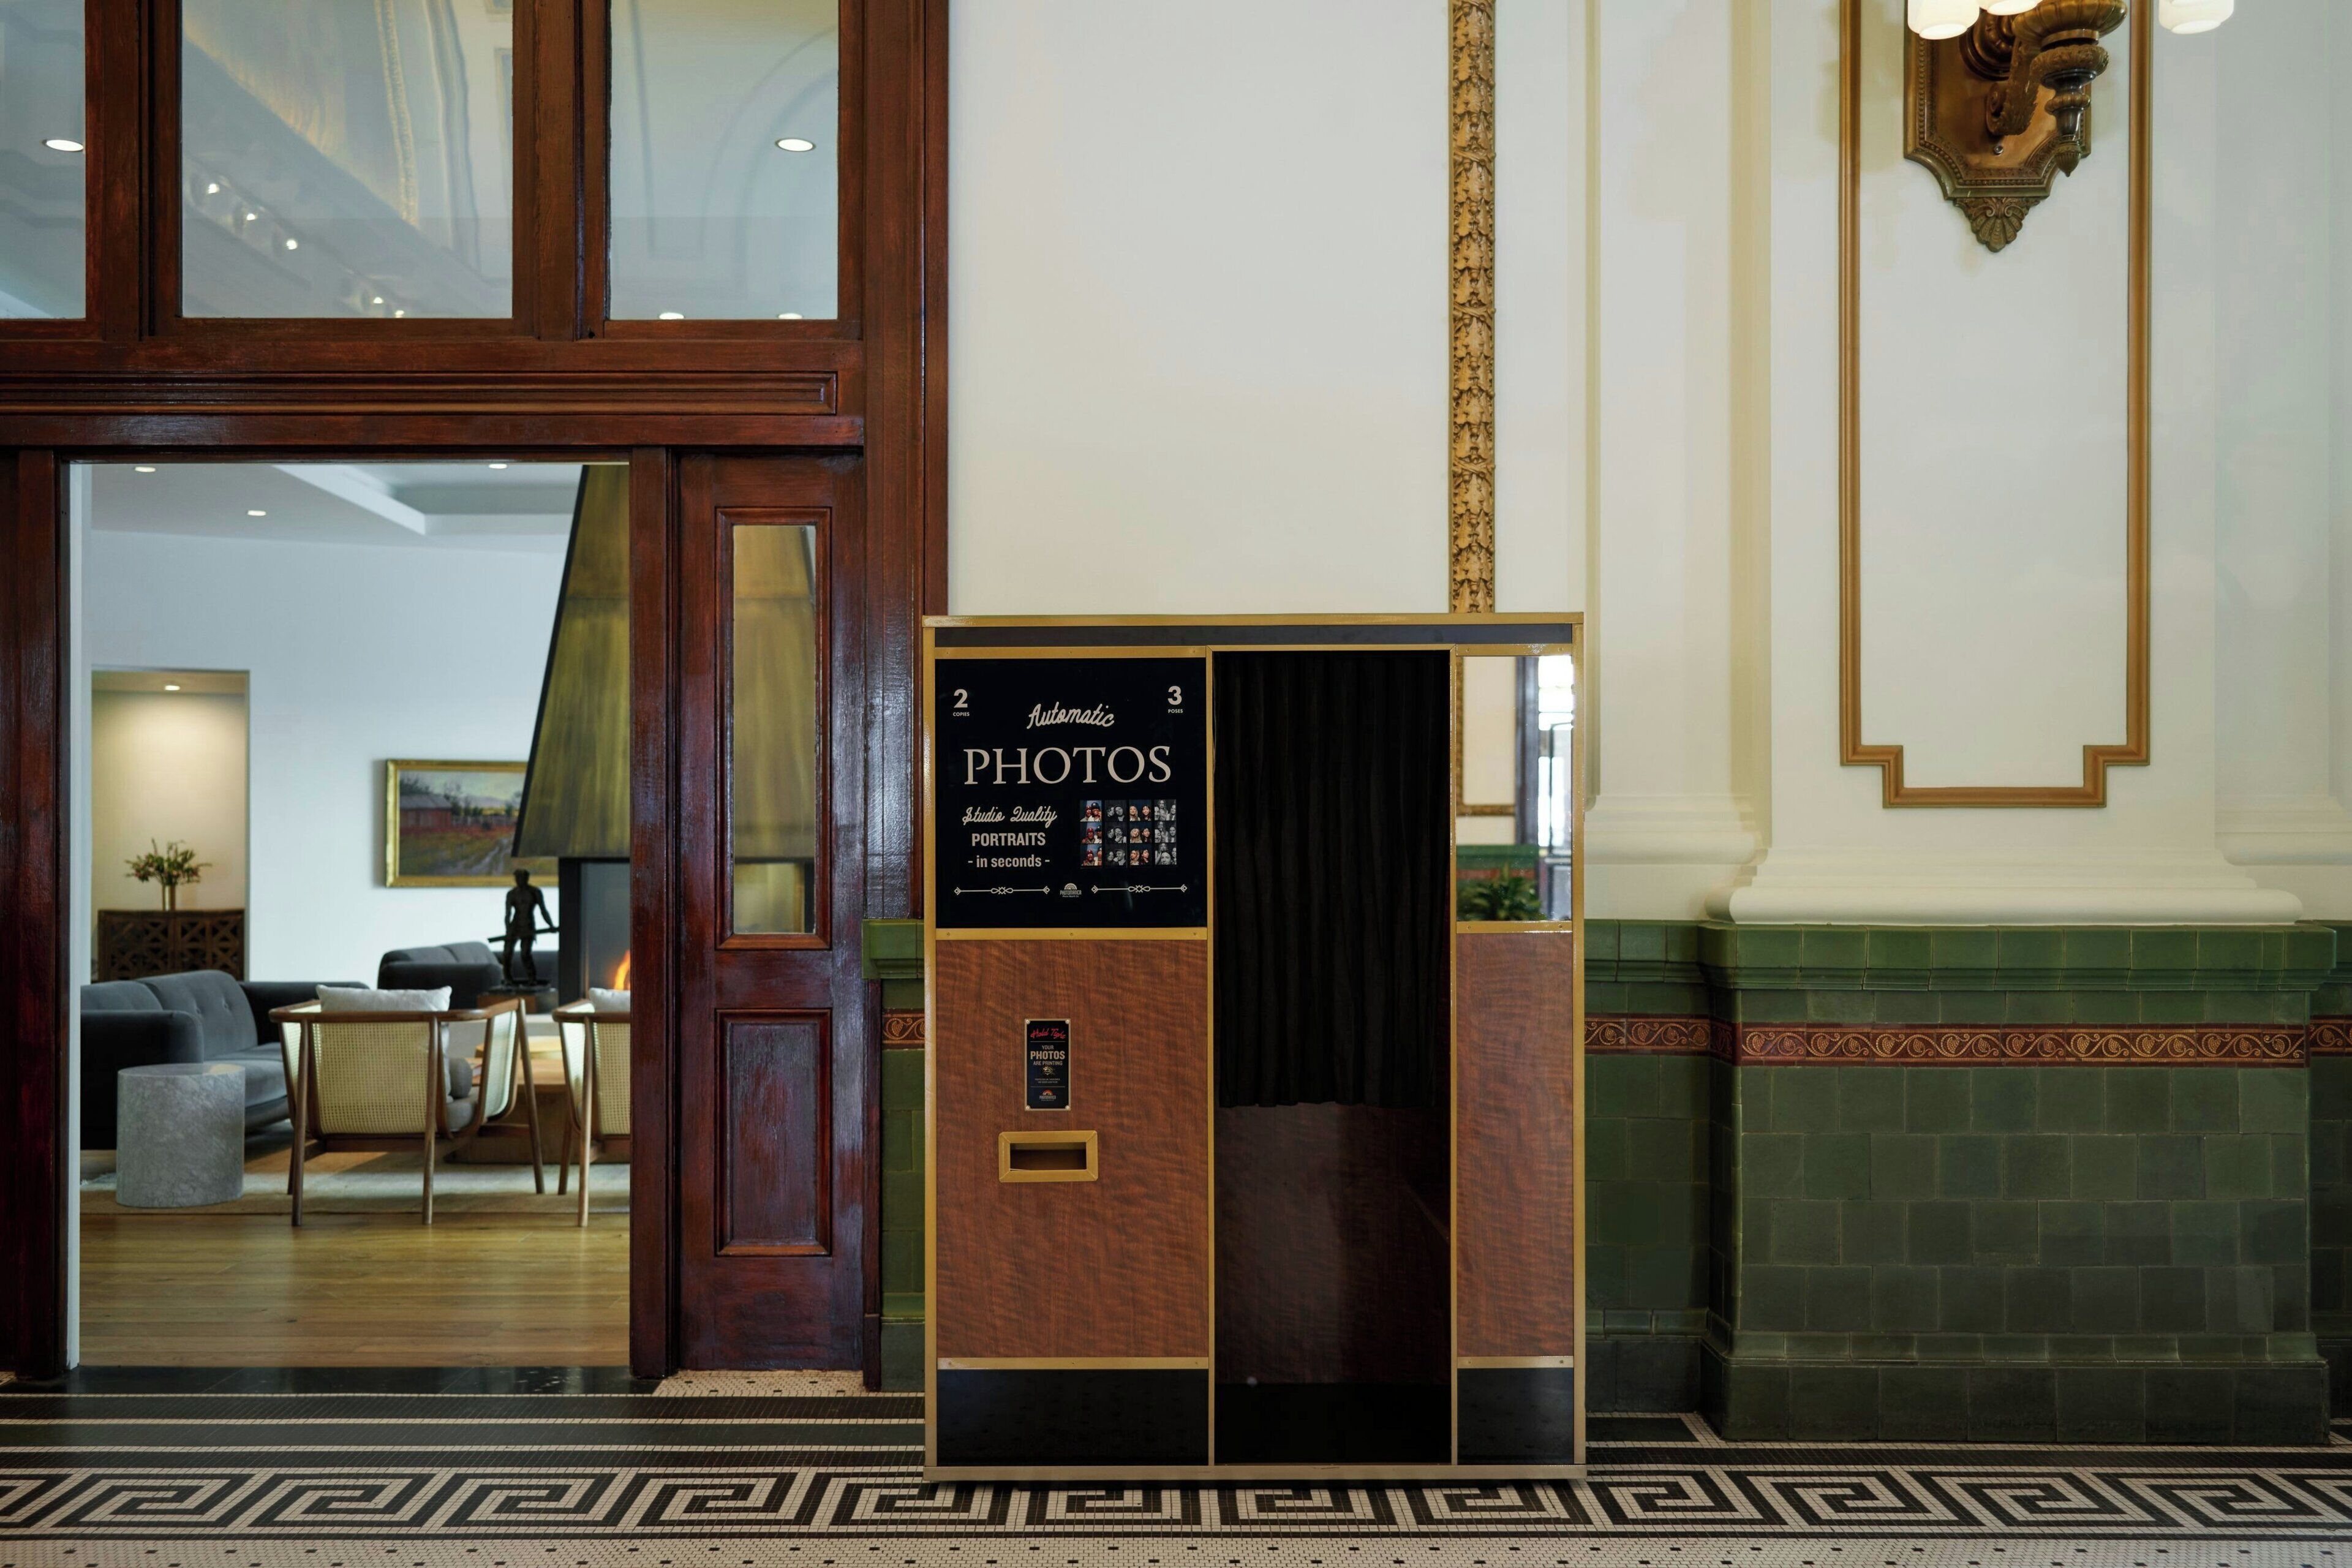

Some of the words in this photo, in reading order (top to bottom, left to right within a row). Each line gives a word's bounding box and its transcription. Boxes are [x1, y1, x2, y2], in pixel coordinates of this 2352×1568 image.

[954, 688, 968, 708] 2
[1167, 685, 1182, 706] 3
[1026, 701, 1115, 729] Automatic
[963, 745, 1171, 785] PHOTOS
[962, 806, 1006, 826] Studio
[1010, 805, 1058, 828] Quality
[971, 832, 1046, 846] PORTRAITS
[1030, 1028, 1049, 1039] Hold
[1030, 1050, 1065, 1060] PHOTOS
